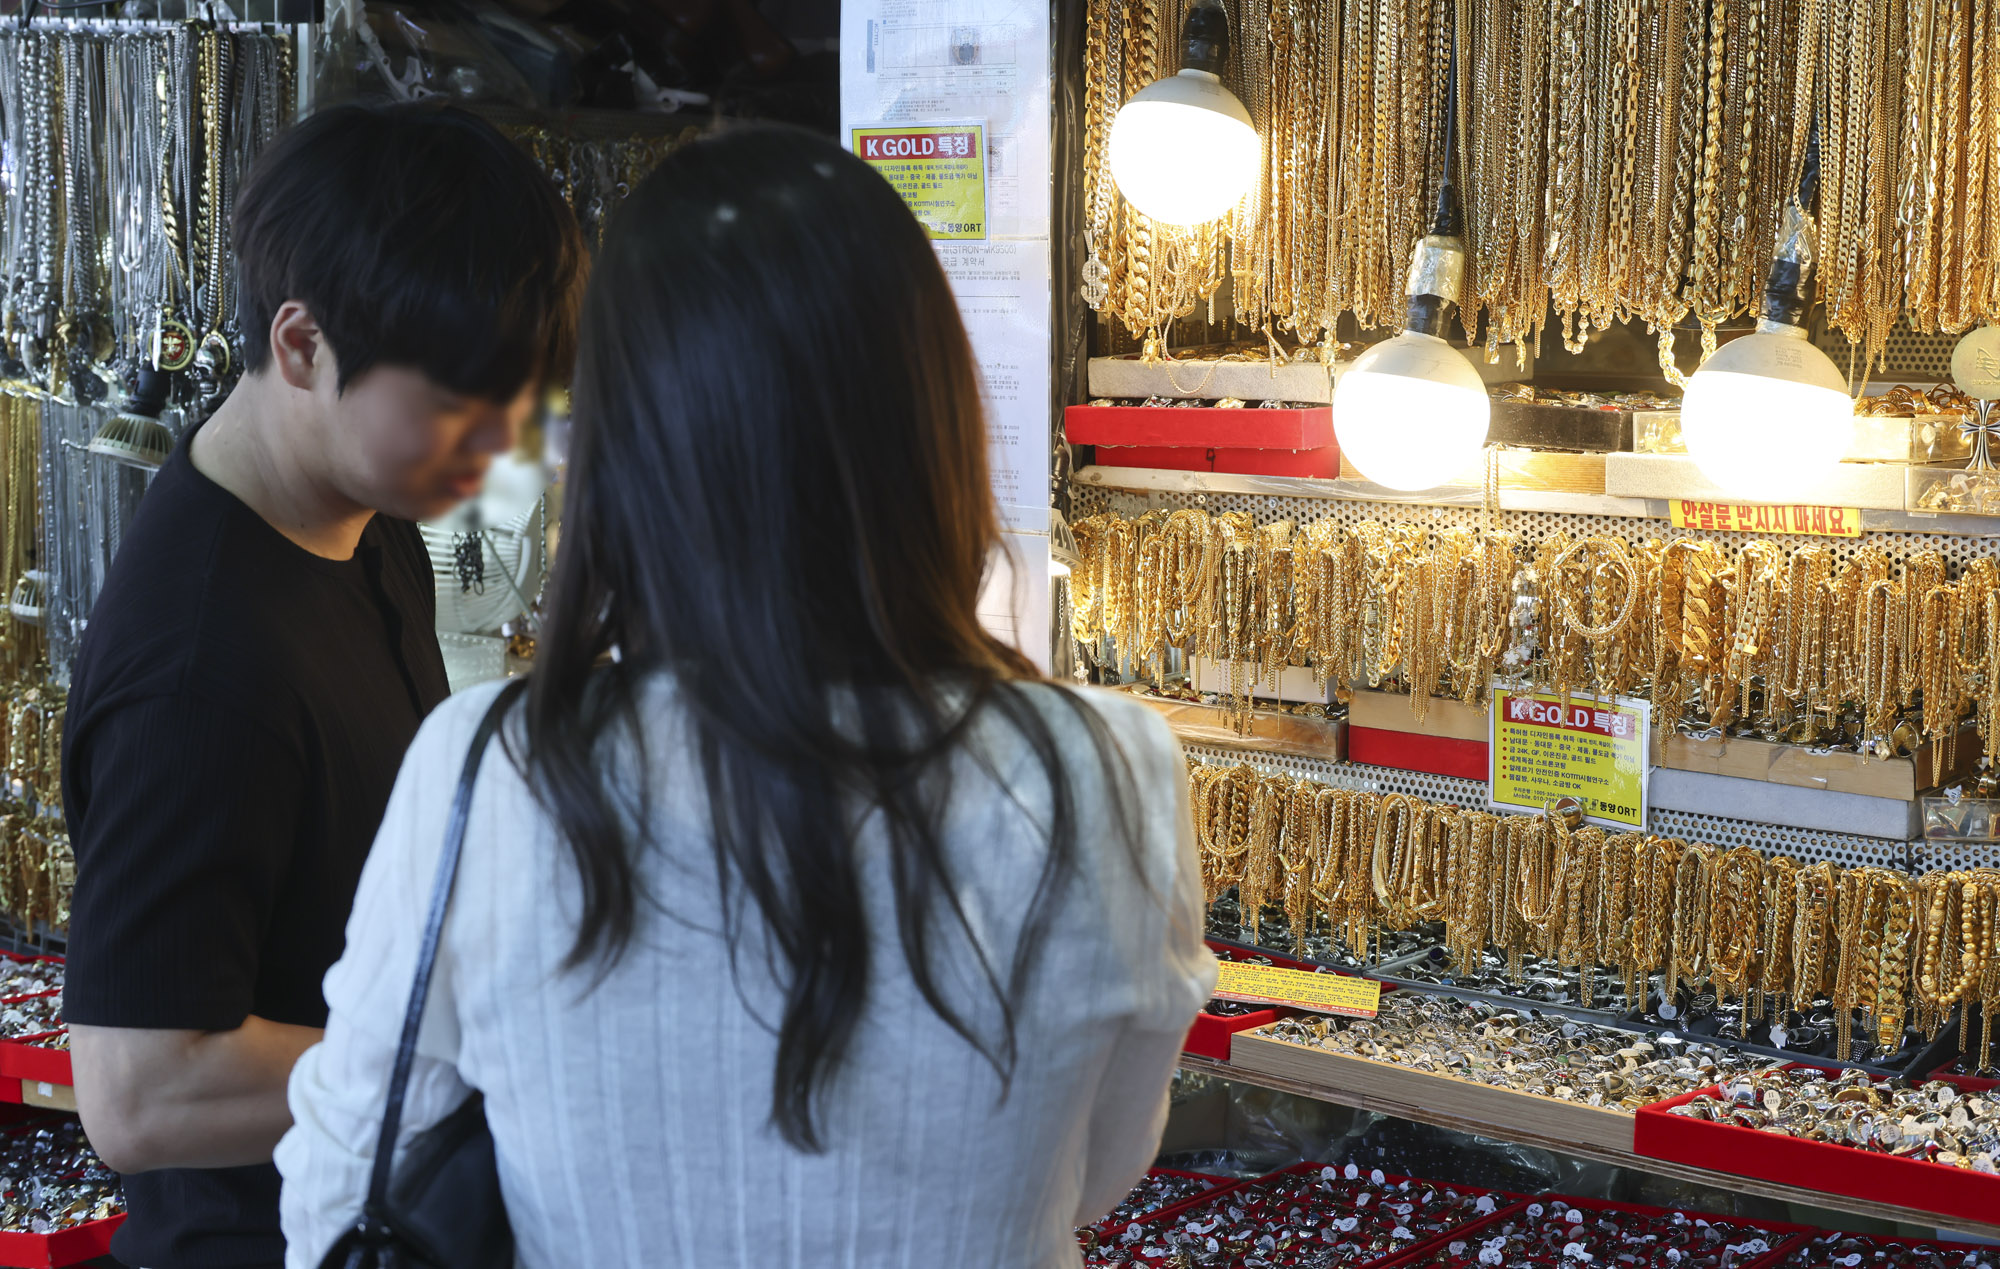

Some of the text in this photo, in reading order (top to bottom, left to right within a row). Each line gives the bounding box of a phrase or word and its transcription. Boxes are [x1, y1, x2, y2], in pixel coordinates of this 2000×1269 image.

[866, 136, 969, 156] K GOLD 특징
[964, 223, 981, 233] ORT
[1511, 701, 1627, 736] K GOLD 특징
[1600, 802, 1637, 818] 동양 ORT
[1219, 961, 1270, 972] KGOLD
